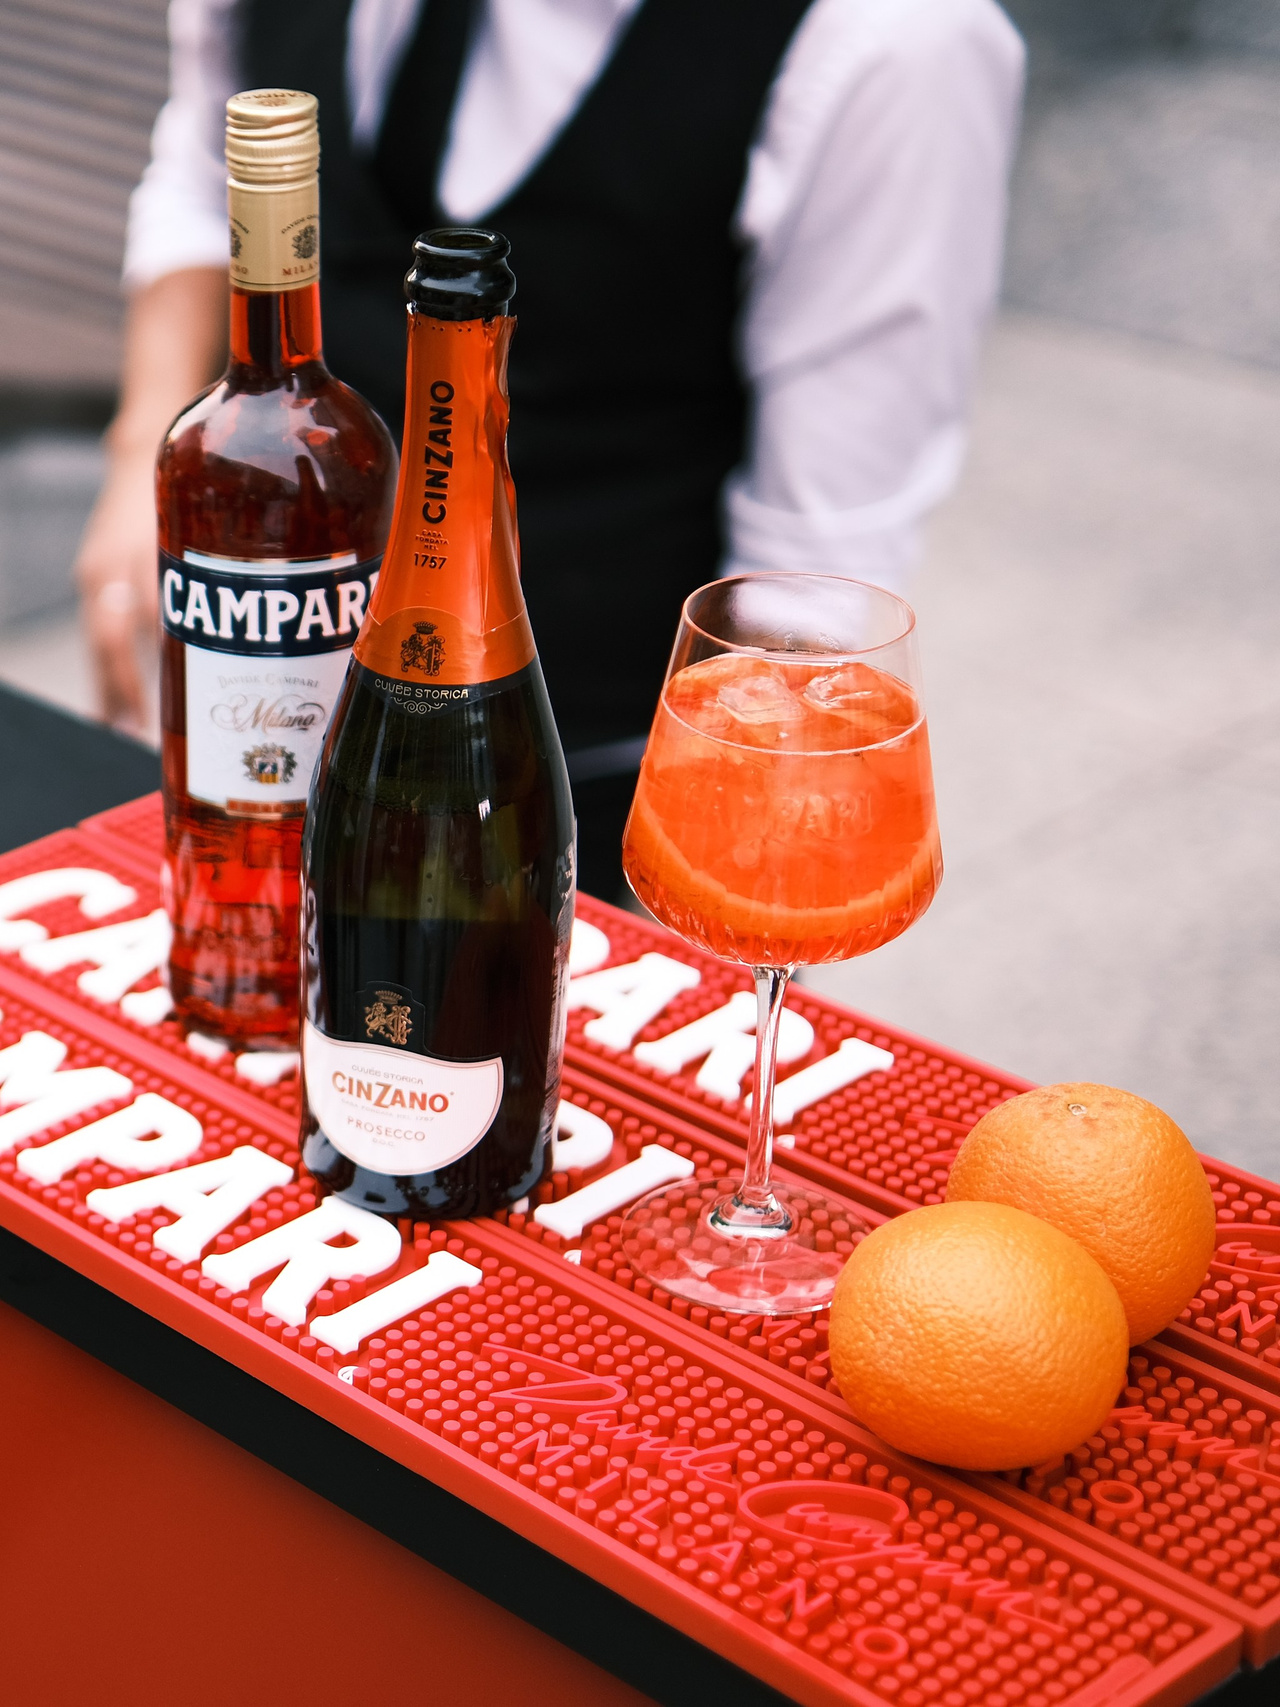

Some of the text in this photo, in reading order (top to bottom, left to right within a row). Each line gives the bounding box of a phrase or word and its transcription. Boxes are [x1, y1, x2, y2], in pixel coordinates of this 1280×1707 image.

[422, 380, 455, 525] CINZANO
[413, 552, 448, 570] 1757
[414, 688, 469, 699] STORICA
[331, 1070, 450, 1113] CINZANO
[383, 1072, 424, 1085] STORICA
[347, 1116, 426, 1142] PROSECCO
[512, 1429, 910, 1661] MILANO
